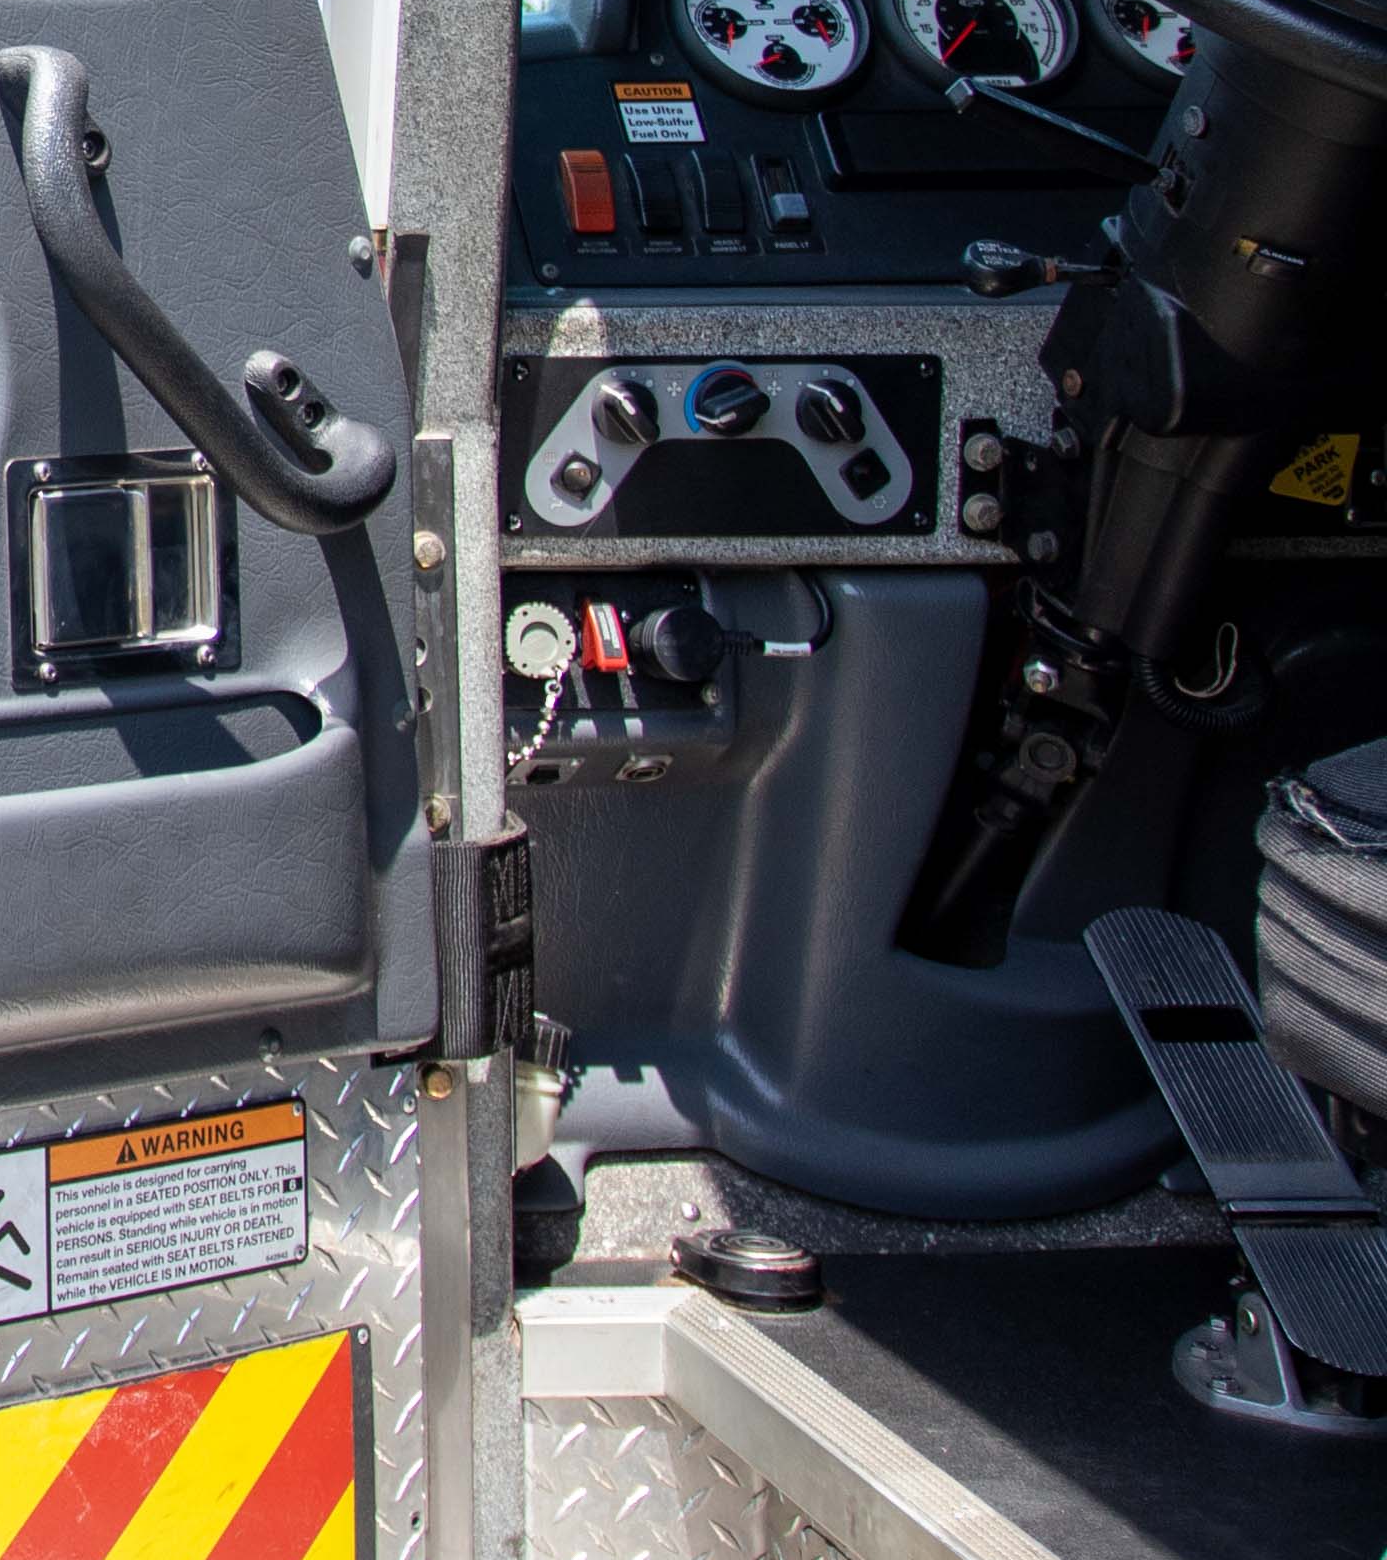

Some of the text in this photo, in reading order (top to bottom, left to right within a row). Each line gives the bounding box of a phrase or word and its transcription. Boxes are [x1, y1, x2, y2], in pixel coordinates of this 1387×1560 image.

[919, 23, 933, 34] 15
[1021, 23, 1039, 34] 75
[623, 87, 684, 96] CAUTION
[624, 106, 684, 115] Use Ultra
[628, 118, 694, 127] Low-Sulfur
[631, 130, 689, 139] Fuel Only
[142, 1121, 244, 1157] WARNING
[55, 1159, 246, 1203] This vehicle is designed for carrying
[55, 1163, 296, 1223] personnel in a SEATED POSITION ONLY. This
[55, 1181, 280, 1236] vehicle is equipped with SEAT BELTS FOR
[55, 1196, 298, 1252] PERSONS. Standing while vehicle is in motion
[55, 1212, 283, 1269] can result in SERIOUS INJURY OR DEATH.
[56, 1226, 294, 1286] Remain seated with SEAT BELTS FASTENED
[56, 1254, 236, 1302] while the VEHICLE IS IN MOTION.
